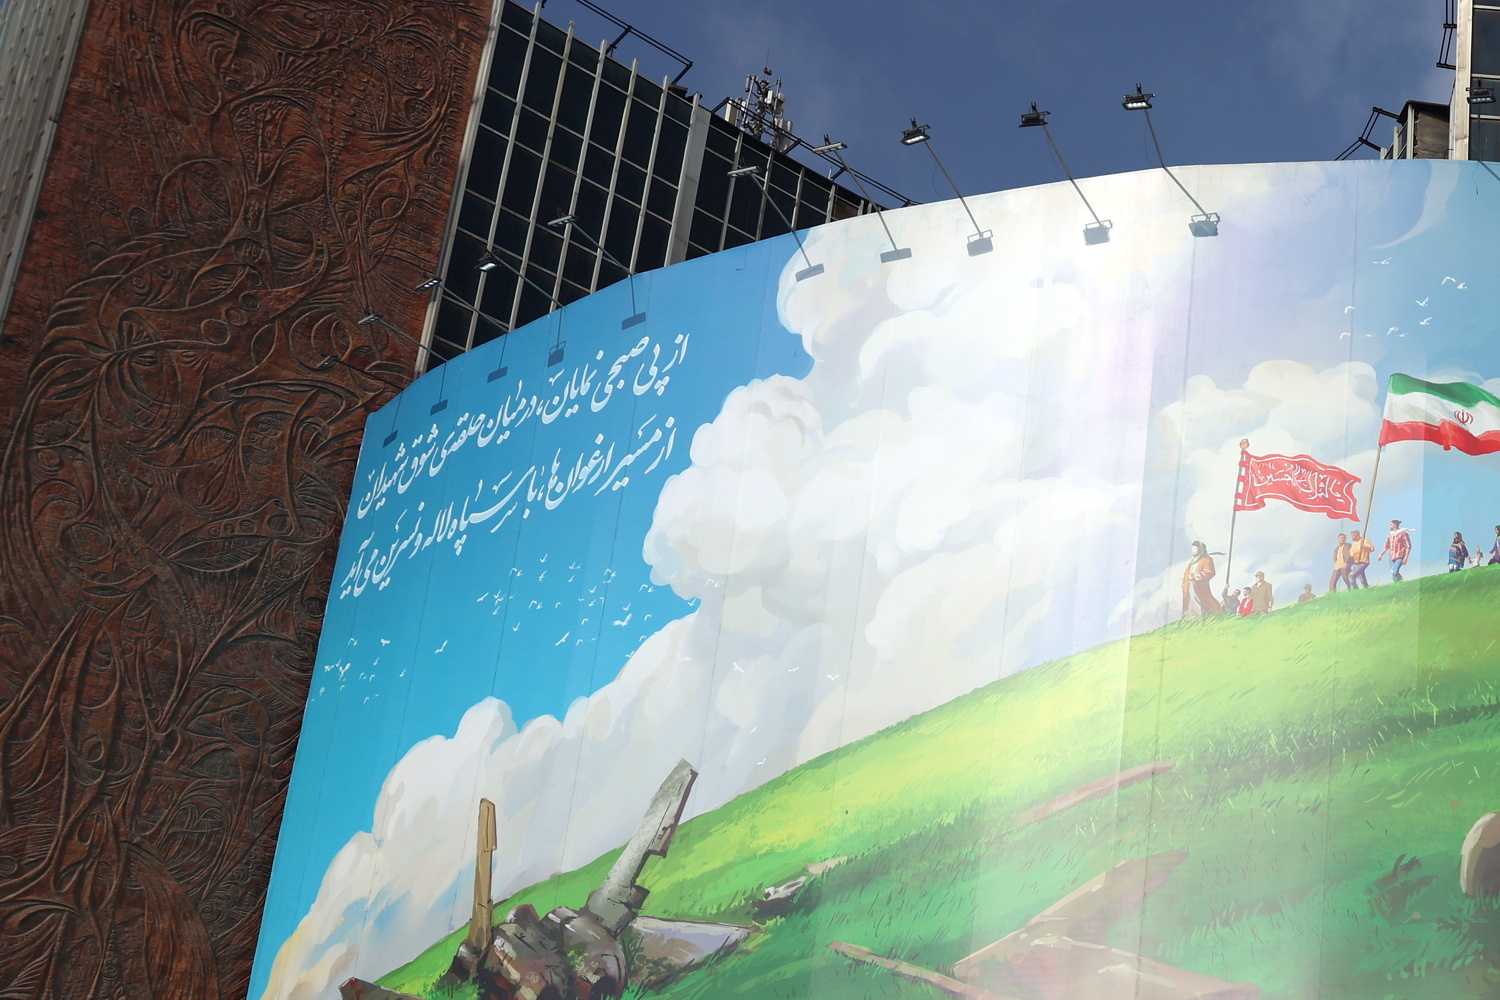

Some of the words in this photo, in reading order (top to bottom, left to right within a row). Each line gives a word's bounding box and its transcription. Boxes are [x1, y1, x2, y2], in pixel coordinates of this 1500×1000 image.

[591, 336, 649, 412] صبحی
[632, 343, 670, 396] پی
[662, 333, 690, 373] از
[477, 390, 527, 447] میان
[515, 395, 538, 427] در
[398, 424, 438, 494] شوق
[594, 418, 662, 496] مسیر
[644, 416, 677, 474] از
[357, 443, 410, 519] شهیدان
[372, 502, 425, 591] نسرین
[409, 533, 422, 559] و
[422, 502, 454, 551] لاله
